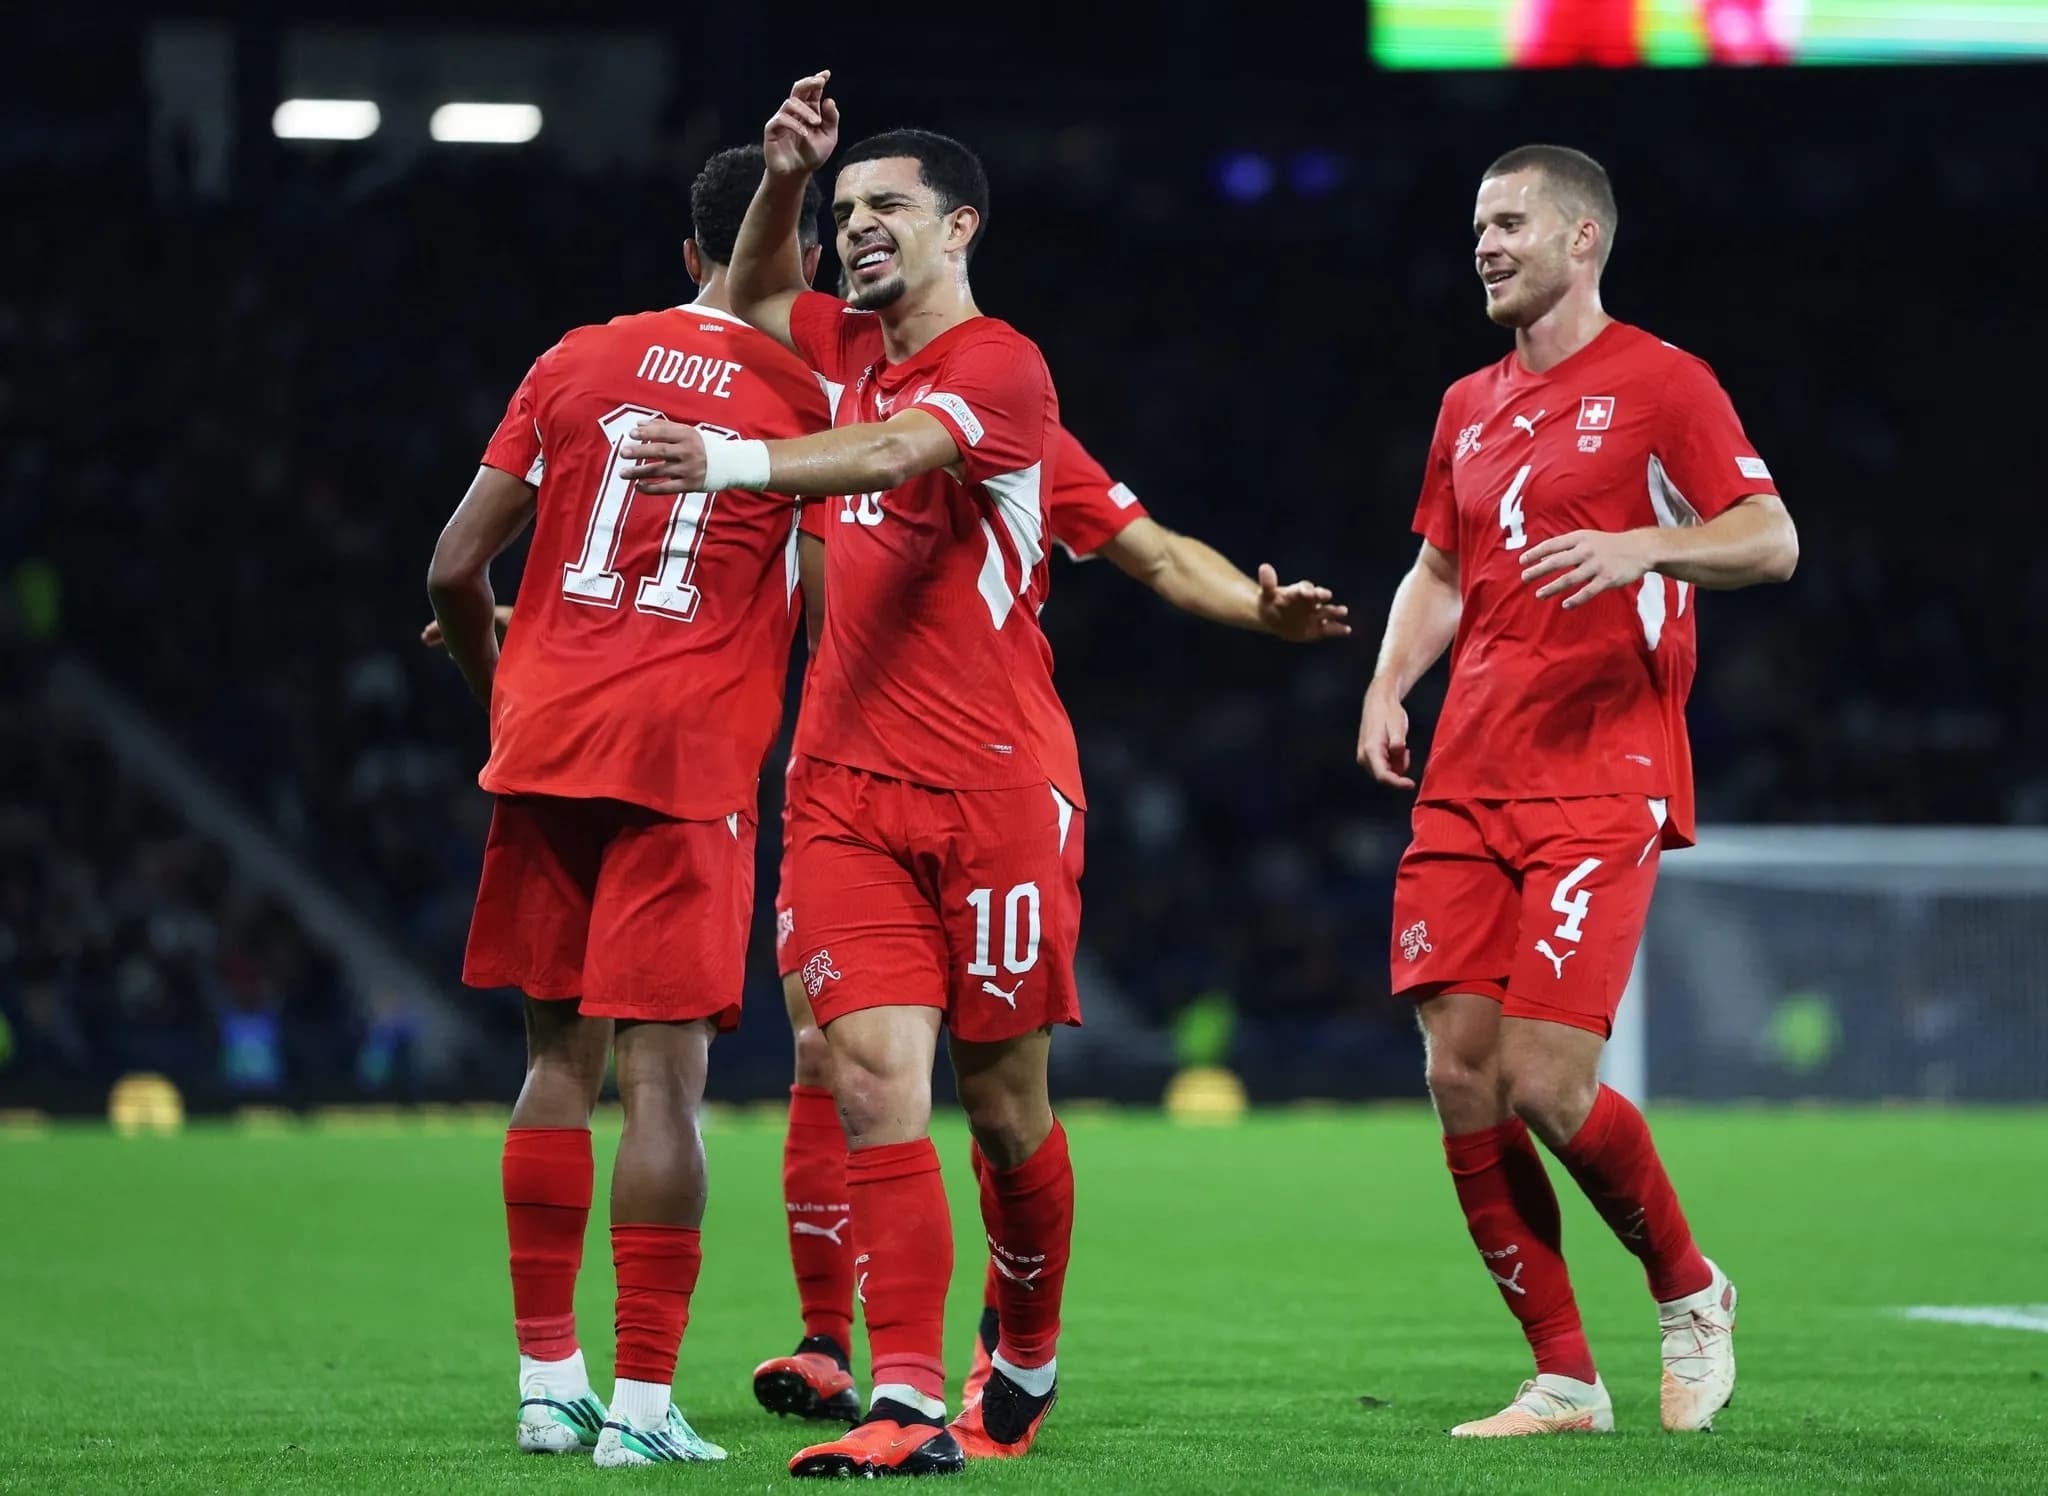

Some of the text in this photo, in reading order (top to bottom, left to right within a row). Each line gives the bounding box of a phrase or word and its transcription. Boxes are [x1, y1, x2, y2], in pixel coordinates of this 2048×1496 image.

[637, 345, 743, 399] NDOYE
[562, 403, 741, 623] 11
[1499, 464, 1532, 550] 4
[966, 881, 1040, 977] 10
[1550, 857, 1603, 943] 4
